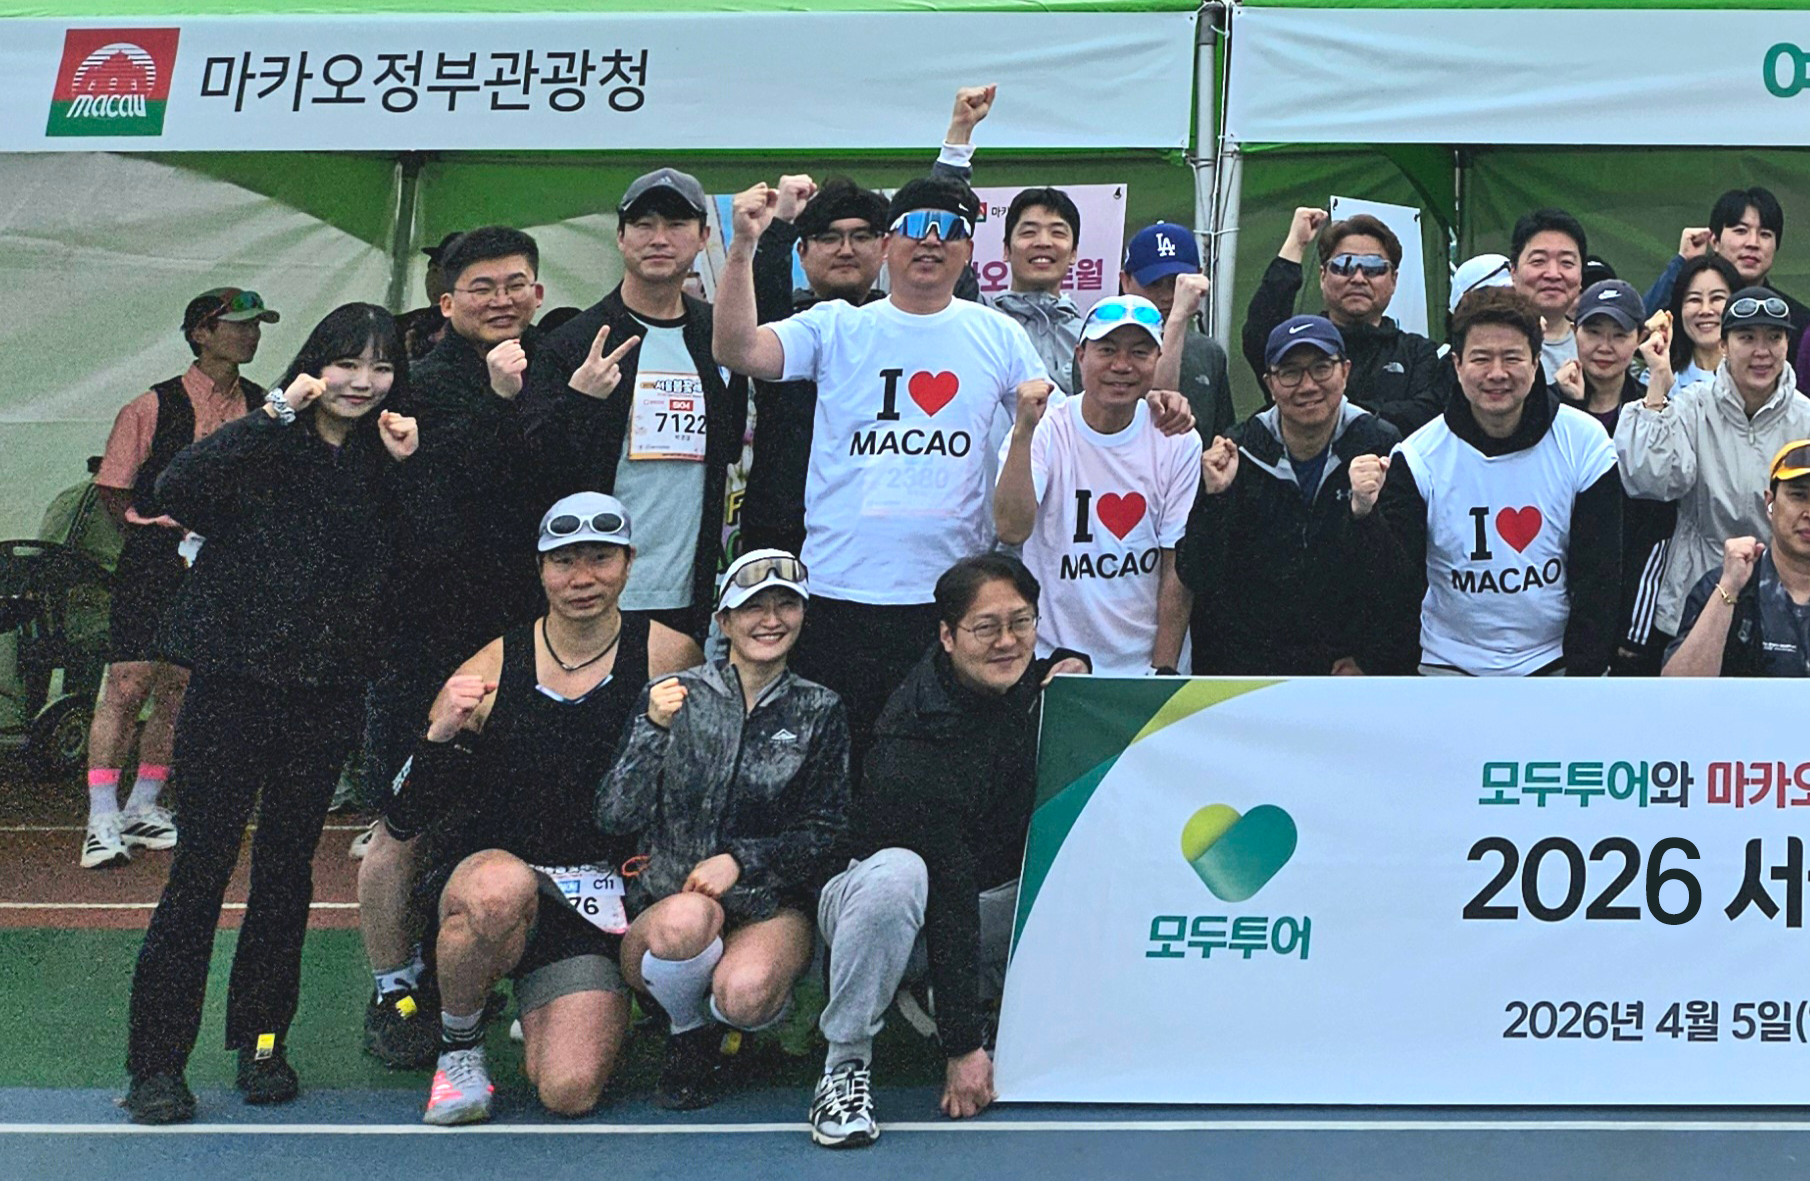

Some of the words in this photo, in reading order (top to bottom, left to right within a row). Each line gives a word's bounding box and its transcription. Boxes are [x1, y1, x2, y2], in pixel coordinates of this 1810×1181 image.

[199, 49, 650, 113] 마카오정부관광청
[66, 93, 147, 118] macau
[1155, 232, 1176, 257] LA
[876, 368, 904, 422] I
[655, 413, 707, 435] 7122
[849, 429, 972, 458] MACAO
[1072, 489, 1094, 544] I
[1469, 506, 1493, 561] I
[1060, 547, 1160, 580] MACAO
[1451, 558, 1562, 594] MACAO
[1478, 760, 1695, 808] 모두투어와
[1463, 836, 1702, 926] 2026
[1145, 915, 1312, 960] 모두투어
[1502, 1000, 1645, 1042] 2026년
[1655, 1000, 1719, 1042] 4월
